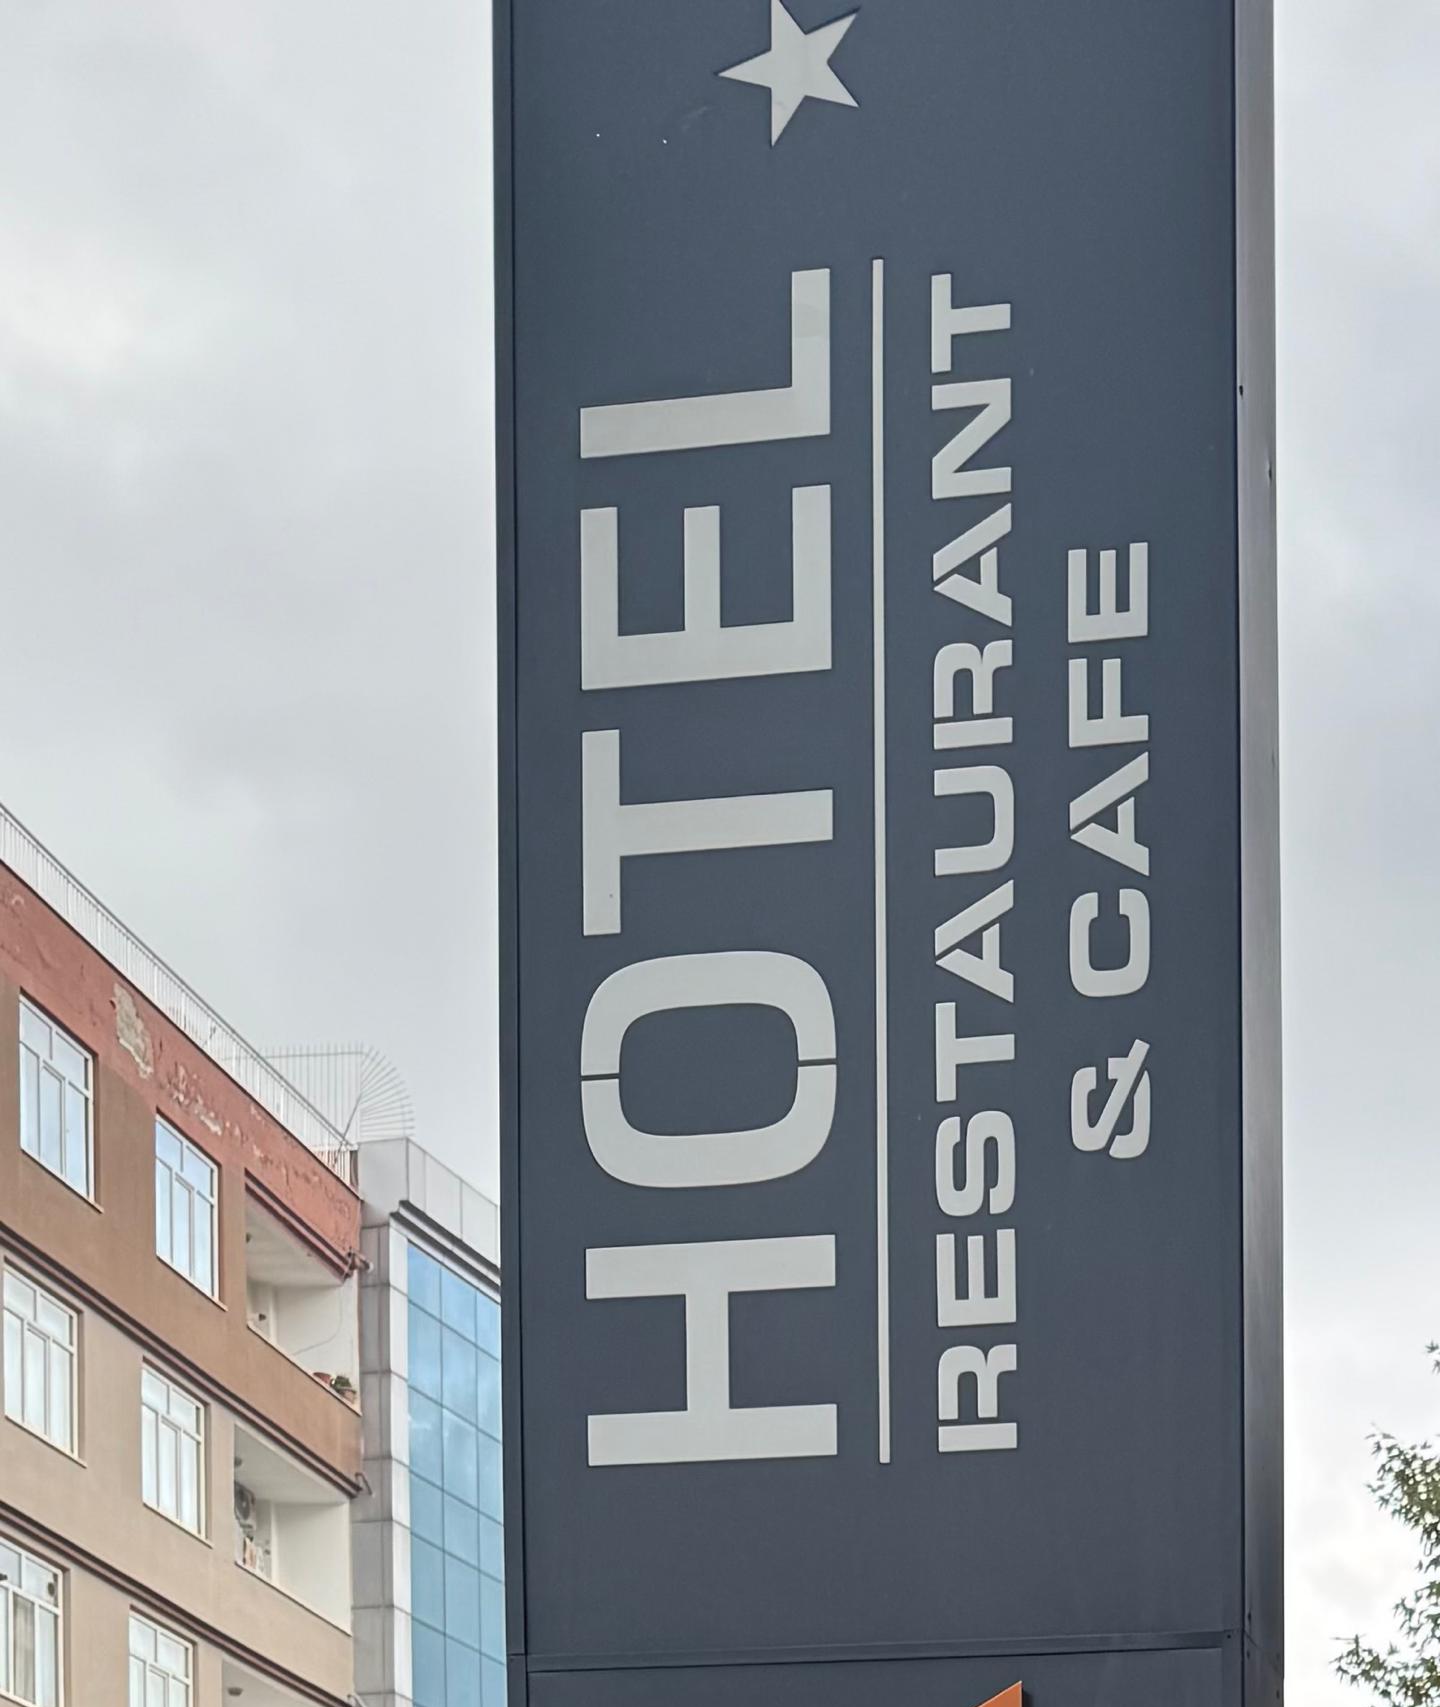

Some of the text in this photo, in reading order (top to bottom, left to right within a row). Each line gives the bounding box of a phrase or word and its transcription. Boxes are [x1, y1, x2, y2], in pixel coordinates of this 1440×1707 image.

[579, 266, 838, 1467] HOTEL
[929, 272, 1018, 1455] RESTAURANT
[1067, 540, 1152, 1160] & CAFE
